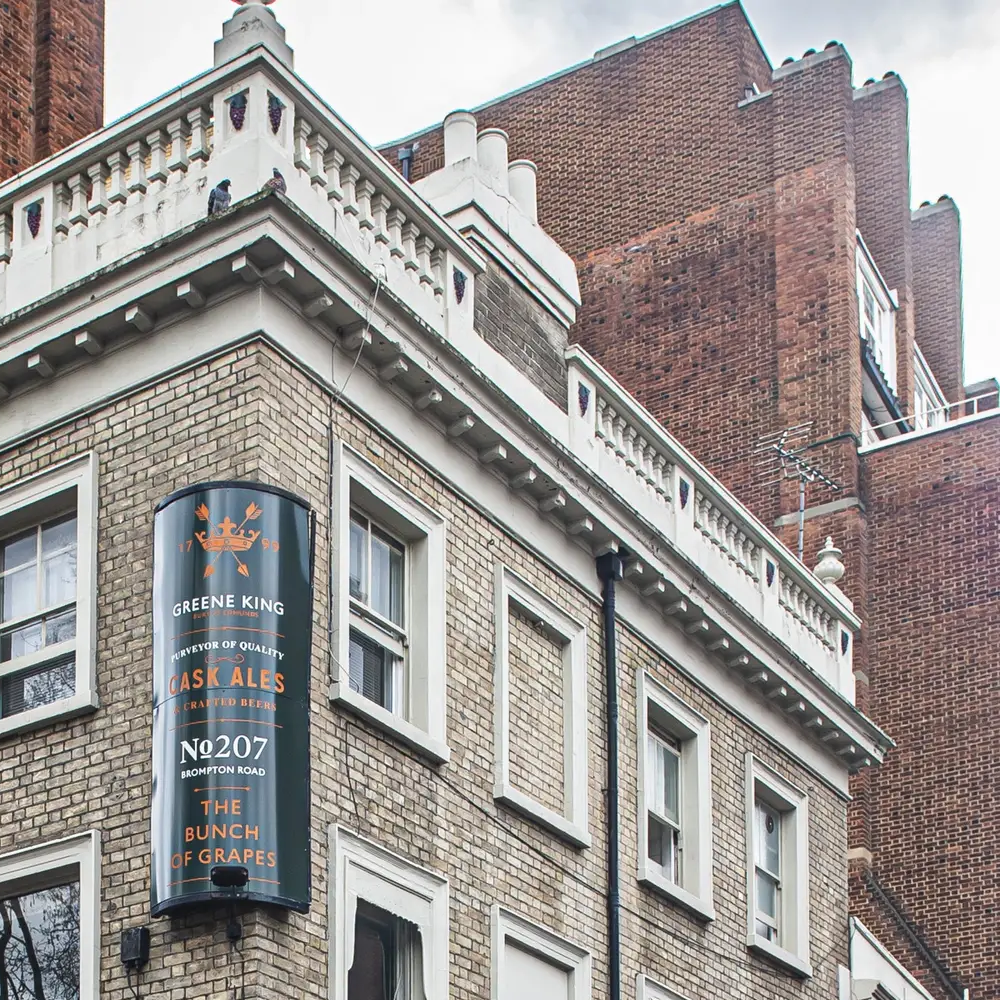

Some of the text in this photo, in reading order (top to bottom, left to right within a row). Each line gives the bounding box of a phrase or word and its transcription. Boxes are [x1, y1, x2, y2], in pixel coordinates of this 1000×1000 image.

[261, 538, 280, 552] 99
[172, 594, 284, 617] GREENE KING
[170, 640, 285, 663] PURVEYOR OF QUALITY
[169, 666, 285, 695] CASK ALES
[183, 697, 236, 711] CRAFTED
[240, 698, 276, 711] BEERS
[181, 765, 266, 779] BROMPTON ROAD
[200, 799, 241, 816] THE
[185, 824, 259, 842] BUNCH
[170, 848, 277, 869] OF GRAPES
